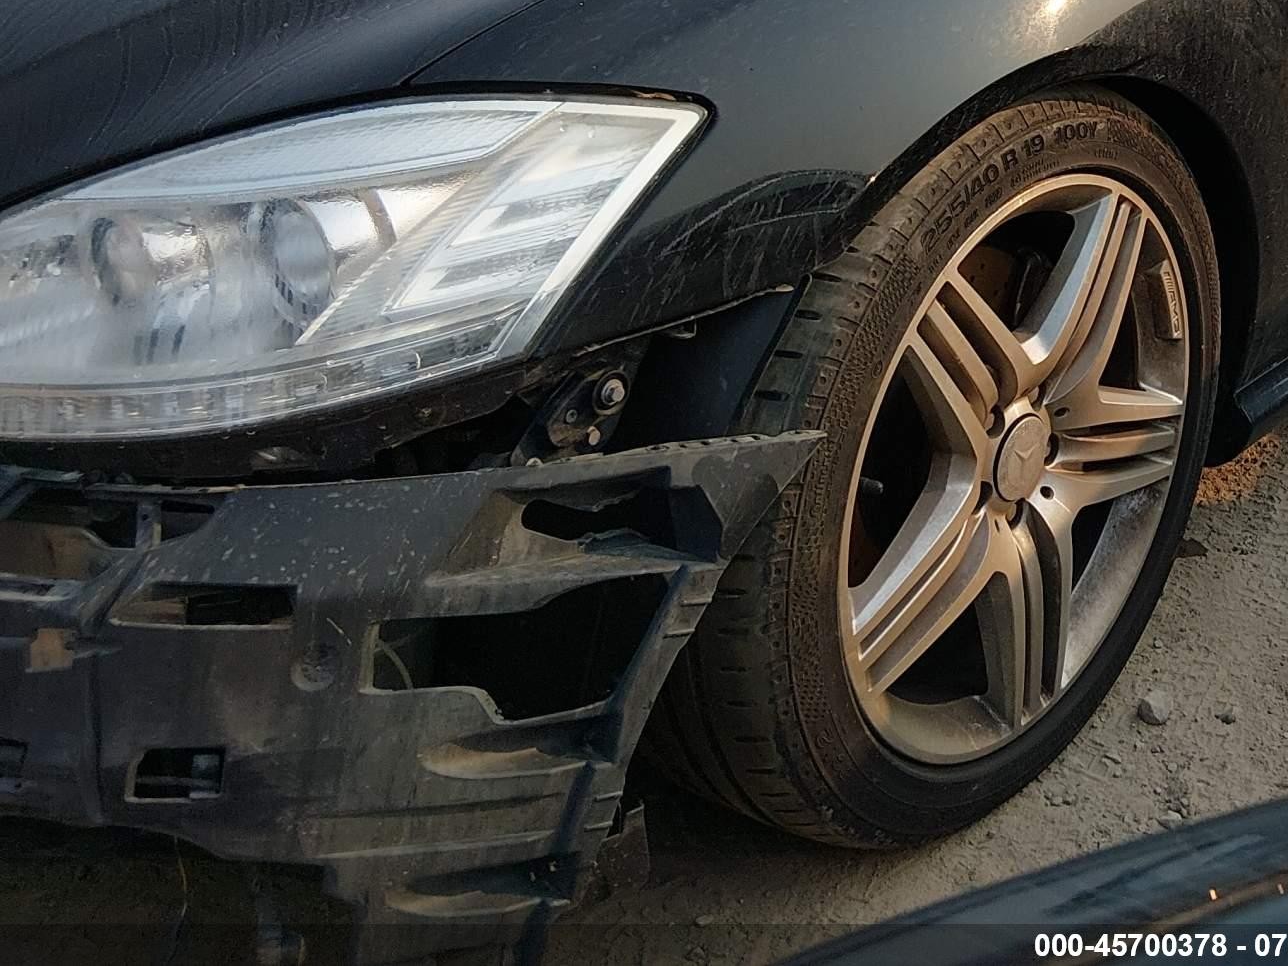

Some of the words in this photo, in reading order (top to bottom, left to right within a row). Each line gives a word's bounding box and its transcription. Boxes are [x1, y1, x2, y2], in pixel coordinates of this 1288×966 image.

[920, 164, 1000, 255] 255/40
[1001, 148, 1019, 172] R
[1021, 134, 1045, 157] 19
[1055, 120, 1099, 142] 100Y
